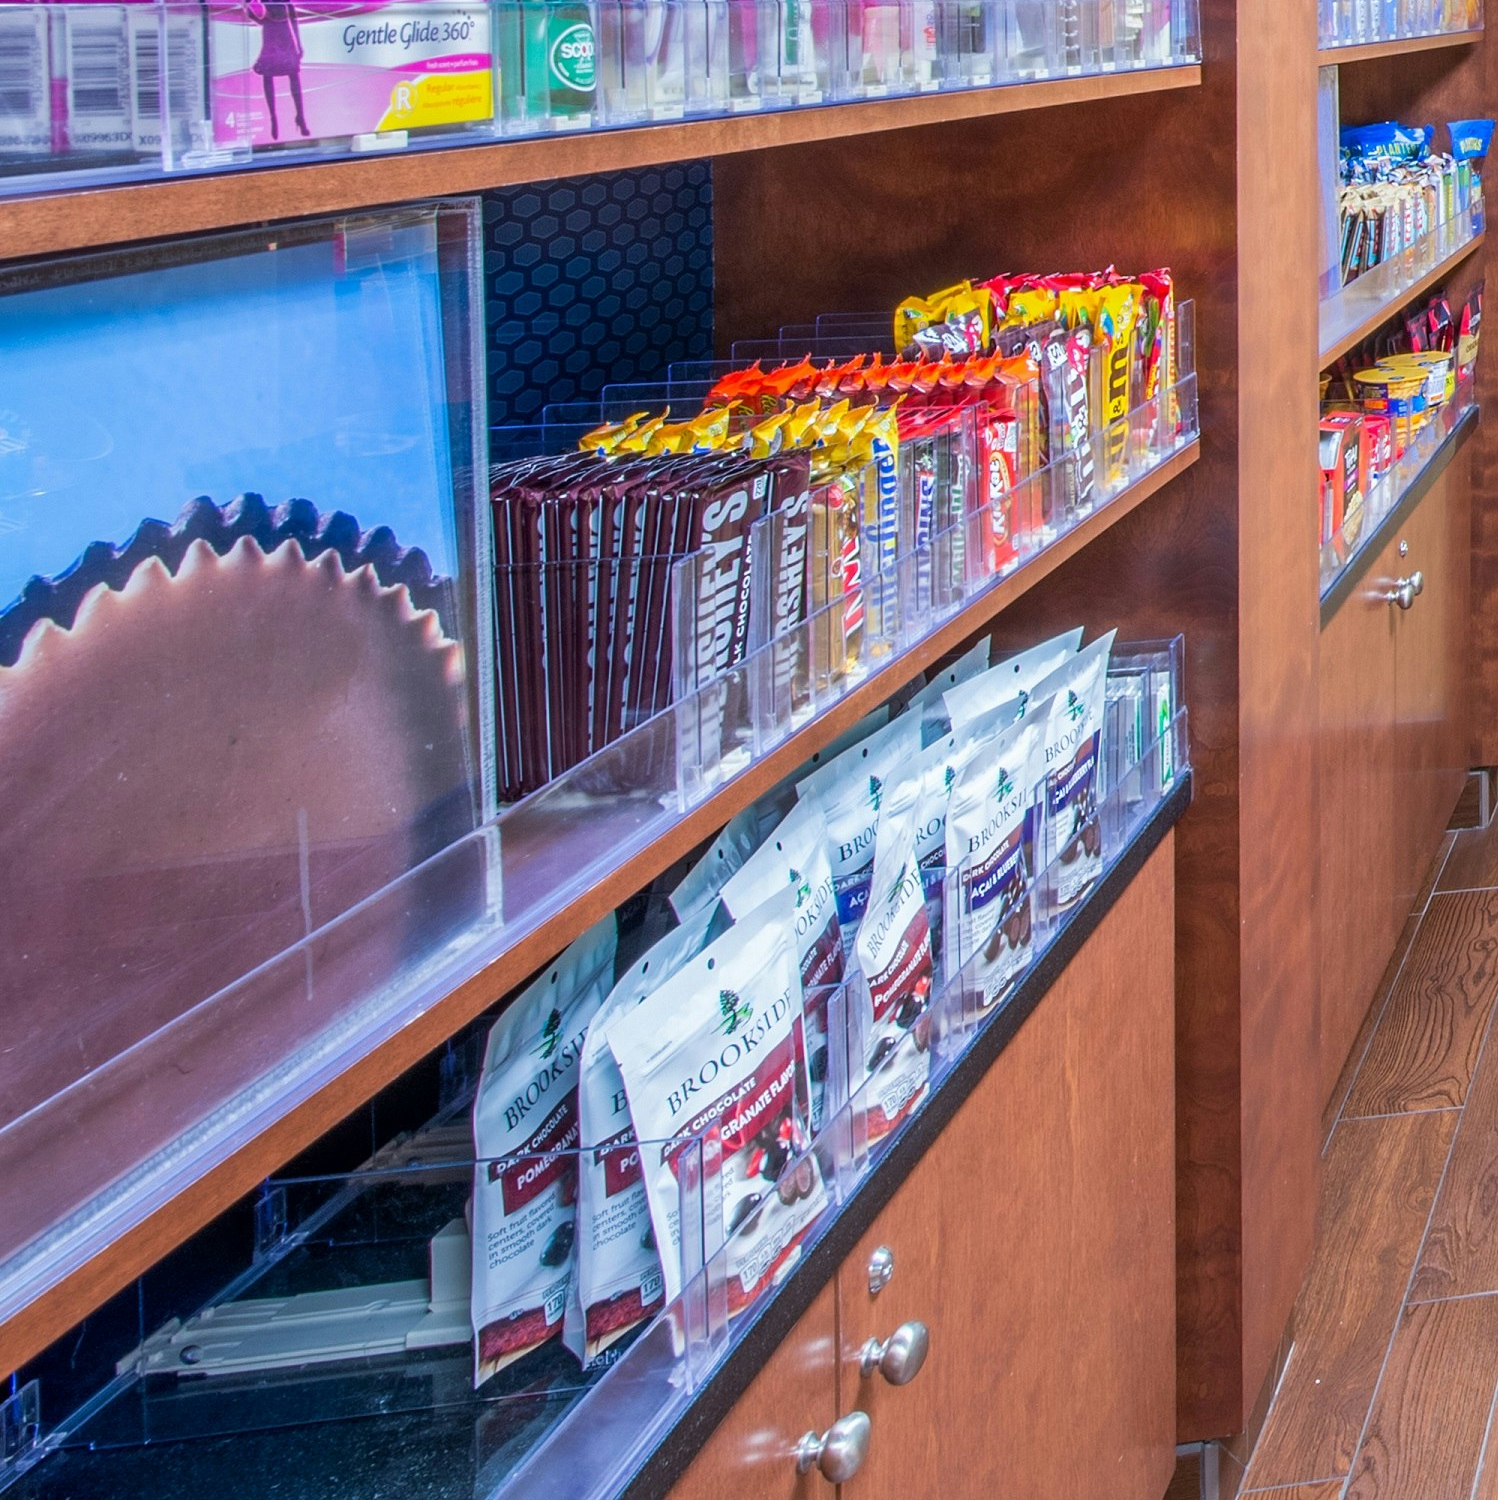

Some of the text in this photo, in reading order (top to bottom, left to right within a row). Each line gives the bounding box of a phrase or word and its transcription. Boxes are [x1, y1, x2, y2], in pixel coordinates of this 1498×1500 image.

[344, 21, 439, 53] Gentle Glide
[225, 111, 235, 128] 4
[985, 840, 1010, 872] CHOCOLATE
[612, 1088, 627, 1116] B
[692, 1076, 756, 1133] CHOCOLATE
[496, 1104, 568, 1174] DARK CHOCOLATE
[600, 1130, 636, 1156] DARK
[487, 1192, 556, 1242] Soft fruit flavored
[488, 1204, 556, 1252] centers, covered
[489, 1232, 535, 1260] in smooth
[592, 1220, 637, 1251] chocolate
[489, 1239, 535, 1270] chocolate
[644, 1274, 661, 1293] 170
[547, 1293, 562, 1311] 170
